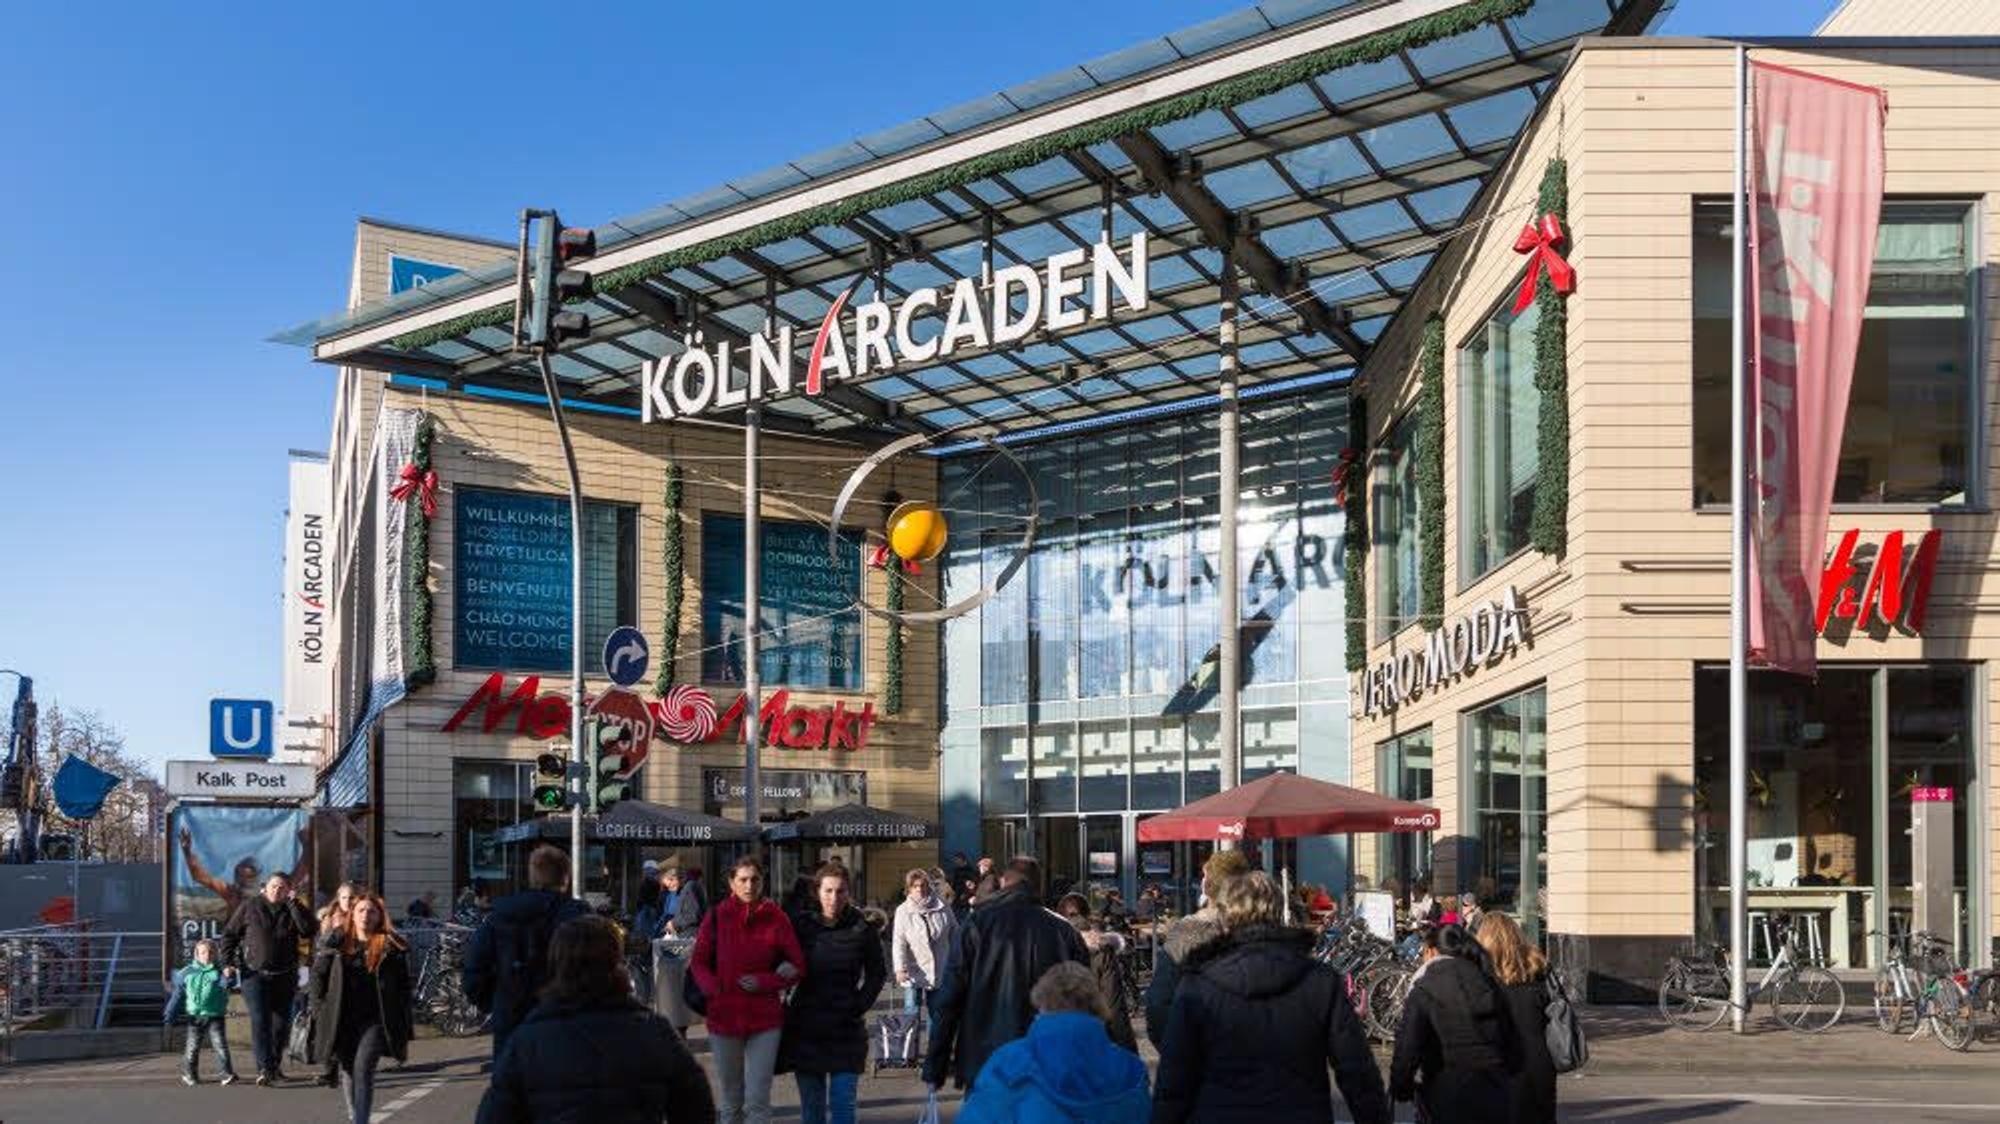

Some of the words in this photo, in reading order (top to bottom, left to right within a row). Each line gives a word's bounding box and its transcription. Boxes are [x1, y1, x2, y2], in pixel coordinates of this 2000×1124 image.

[641, 322, 791, 424] KÖLN
[806, 231, 1149, 395] ARCADEN
[298, 513, 325, 608] ARCADEN
[464, 541, 569, 562] TERVETULOA
[466, 577, 568, 598] BENVENUTI
[299, 611, 323, 663] KÖLN
[466, 629, 569, 650] WELCOME
[1362, 650, 1415, 715] VERO
[1422, 585, 1522, 689] MODA
[223, 706, 261, 749] U
[197, 771, 236, 788] Kalk
[246, 772, 286, 788] Post
[764, 786, 801, 798] FELLOWS
[605, 823, 653, 838] COFFEE
[656, 825, 712, 840] FELLOWS
[833, 823, 875, 836] COFFEE
[878, 823, 926, 838] FELLOWS
